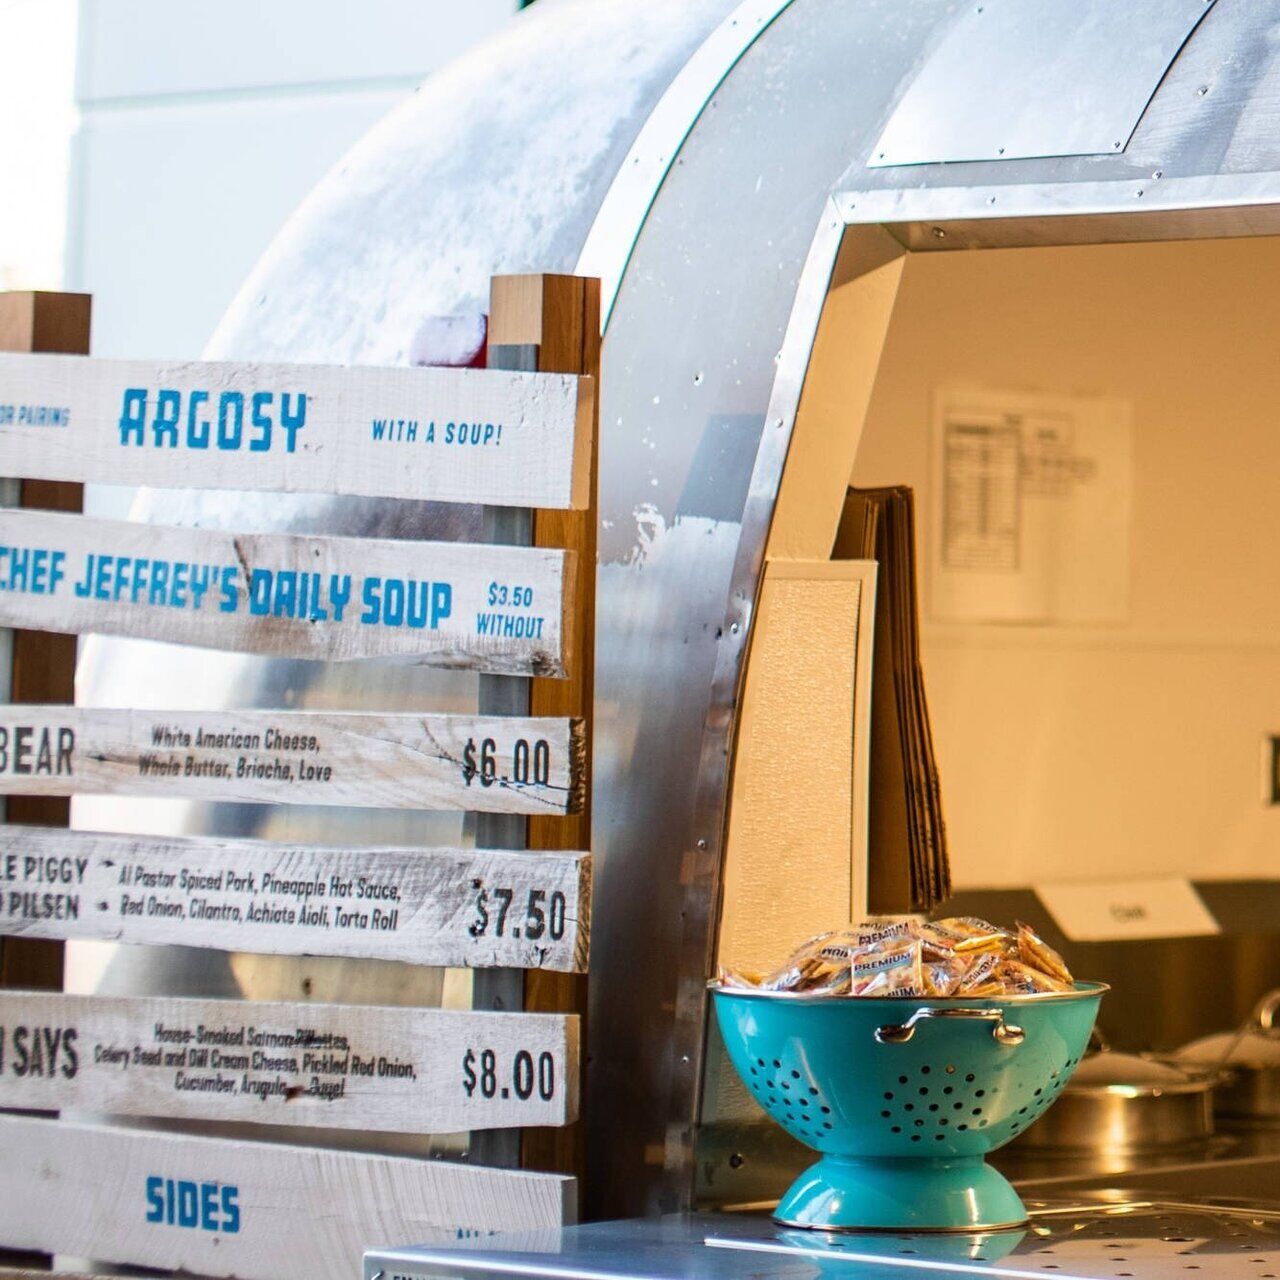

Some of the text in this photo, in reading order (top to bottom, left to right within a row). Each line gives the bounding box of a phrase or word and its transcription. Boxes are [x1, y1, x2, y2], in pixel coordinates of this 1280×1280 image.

[119, 388, 307, 453] ARGOSY
[372, 418, 503, 446] WITH A SOUP!
[0, 546, 453, 629] CHEF JEFFREY'S DAILY SOUP
[488, 581, 533, 608] $3.50
[476, 613, 544, 639] WITHOUT
[151, 726, 320, 754] White American Cheese,
[138, 754, 182, 776] Whole
[184, 755, 232, 780] Butter,
[299, 759, 333, 782] Love
[462, 737, 550, 789] $6.00
[24, 856, 88, 884] PIGGY
[118, 864, 401, 904] Al Pastor Spiced Pork, Pineapple Hot Sauce,
[8, 892, 79, 920] PILSEN
[120, 893, 143, 916] Red
[148, 895, 186, 921] Onion,
[189, 897, 243, 925] Cilantro,
[298, 903, 330, 929] Aioli,
[335, 905, 368, 930] Torta
[371, 908, 399, 932] Roll
[472, 887, 566, 942] $7.50
[858, 922, 909, 946] PREMIUM
[854, 952, 912, 972] PREMIUM
[12, 1025, 79, 1080] SAYS
[165, 1046, 187, 1067] and
[189, 1048, 208, 1069] Dill
[211, 1048, 249, 1071] Cream
[302, 1052, 349, 1076] Pickled
[351, 1055, 375, 1077] Red
[377, 1057, 417, 1082] Onion,
[175, 1070, 238, 1097] Cucumber,
[462, 1047, 555, 1102] $8.00
[145, 1176, 241, 1234] SIDES
